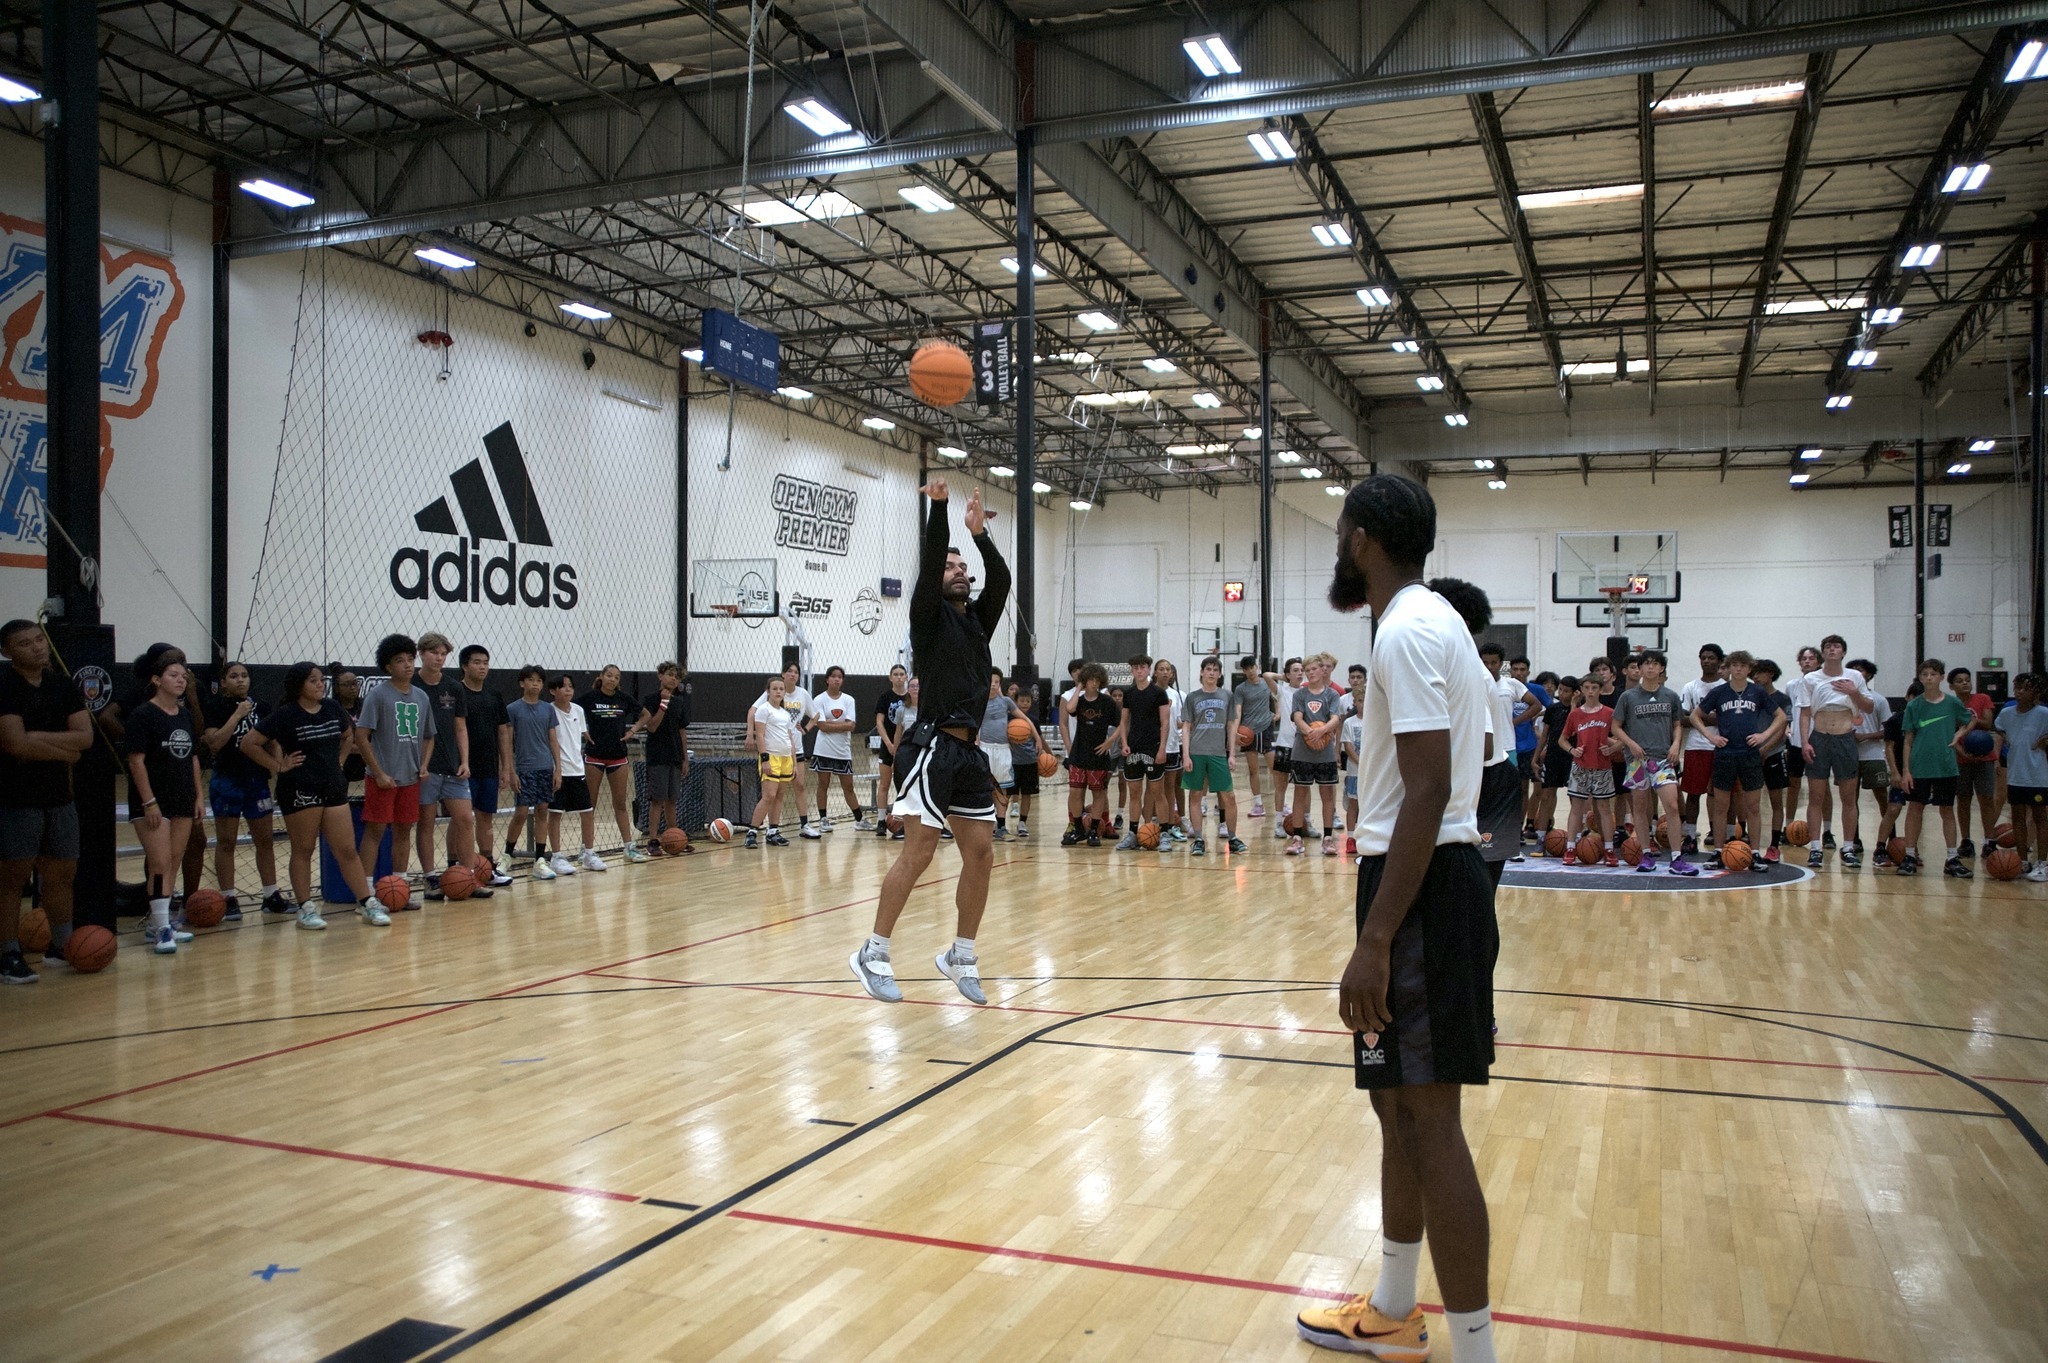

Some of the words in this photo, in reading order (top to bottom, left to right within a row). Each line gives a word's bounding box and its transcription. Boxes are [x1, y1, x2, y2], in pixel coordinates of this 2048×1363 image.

[762, 357, 775, 369] GUEST
[996, 336, 1010, 401] VOLLEYBALL
[774, 480, 819, 513] OPEN
[821, 489, 856, 520] GYM
[1893, 520, 1900, 529] B
[778, 515, 849, 552] PREMIER
[1892, 530, 1901, 541] 4
[1939, 529, 1948, 540] 3
[389, 537, 578, 610] adidas
[1948, 633, 1965, 642] EXIT
[1720, 699, 1757, 713] WILDCATS
[395, 701, 419, 738] H
[1361, 1049, 1385, 1060] PGC
